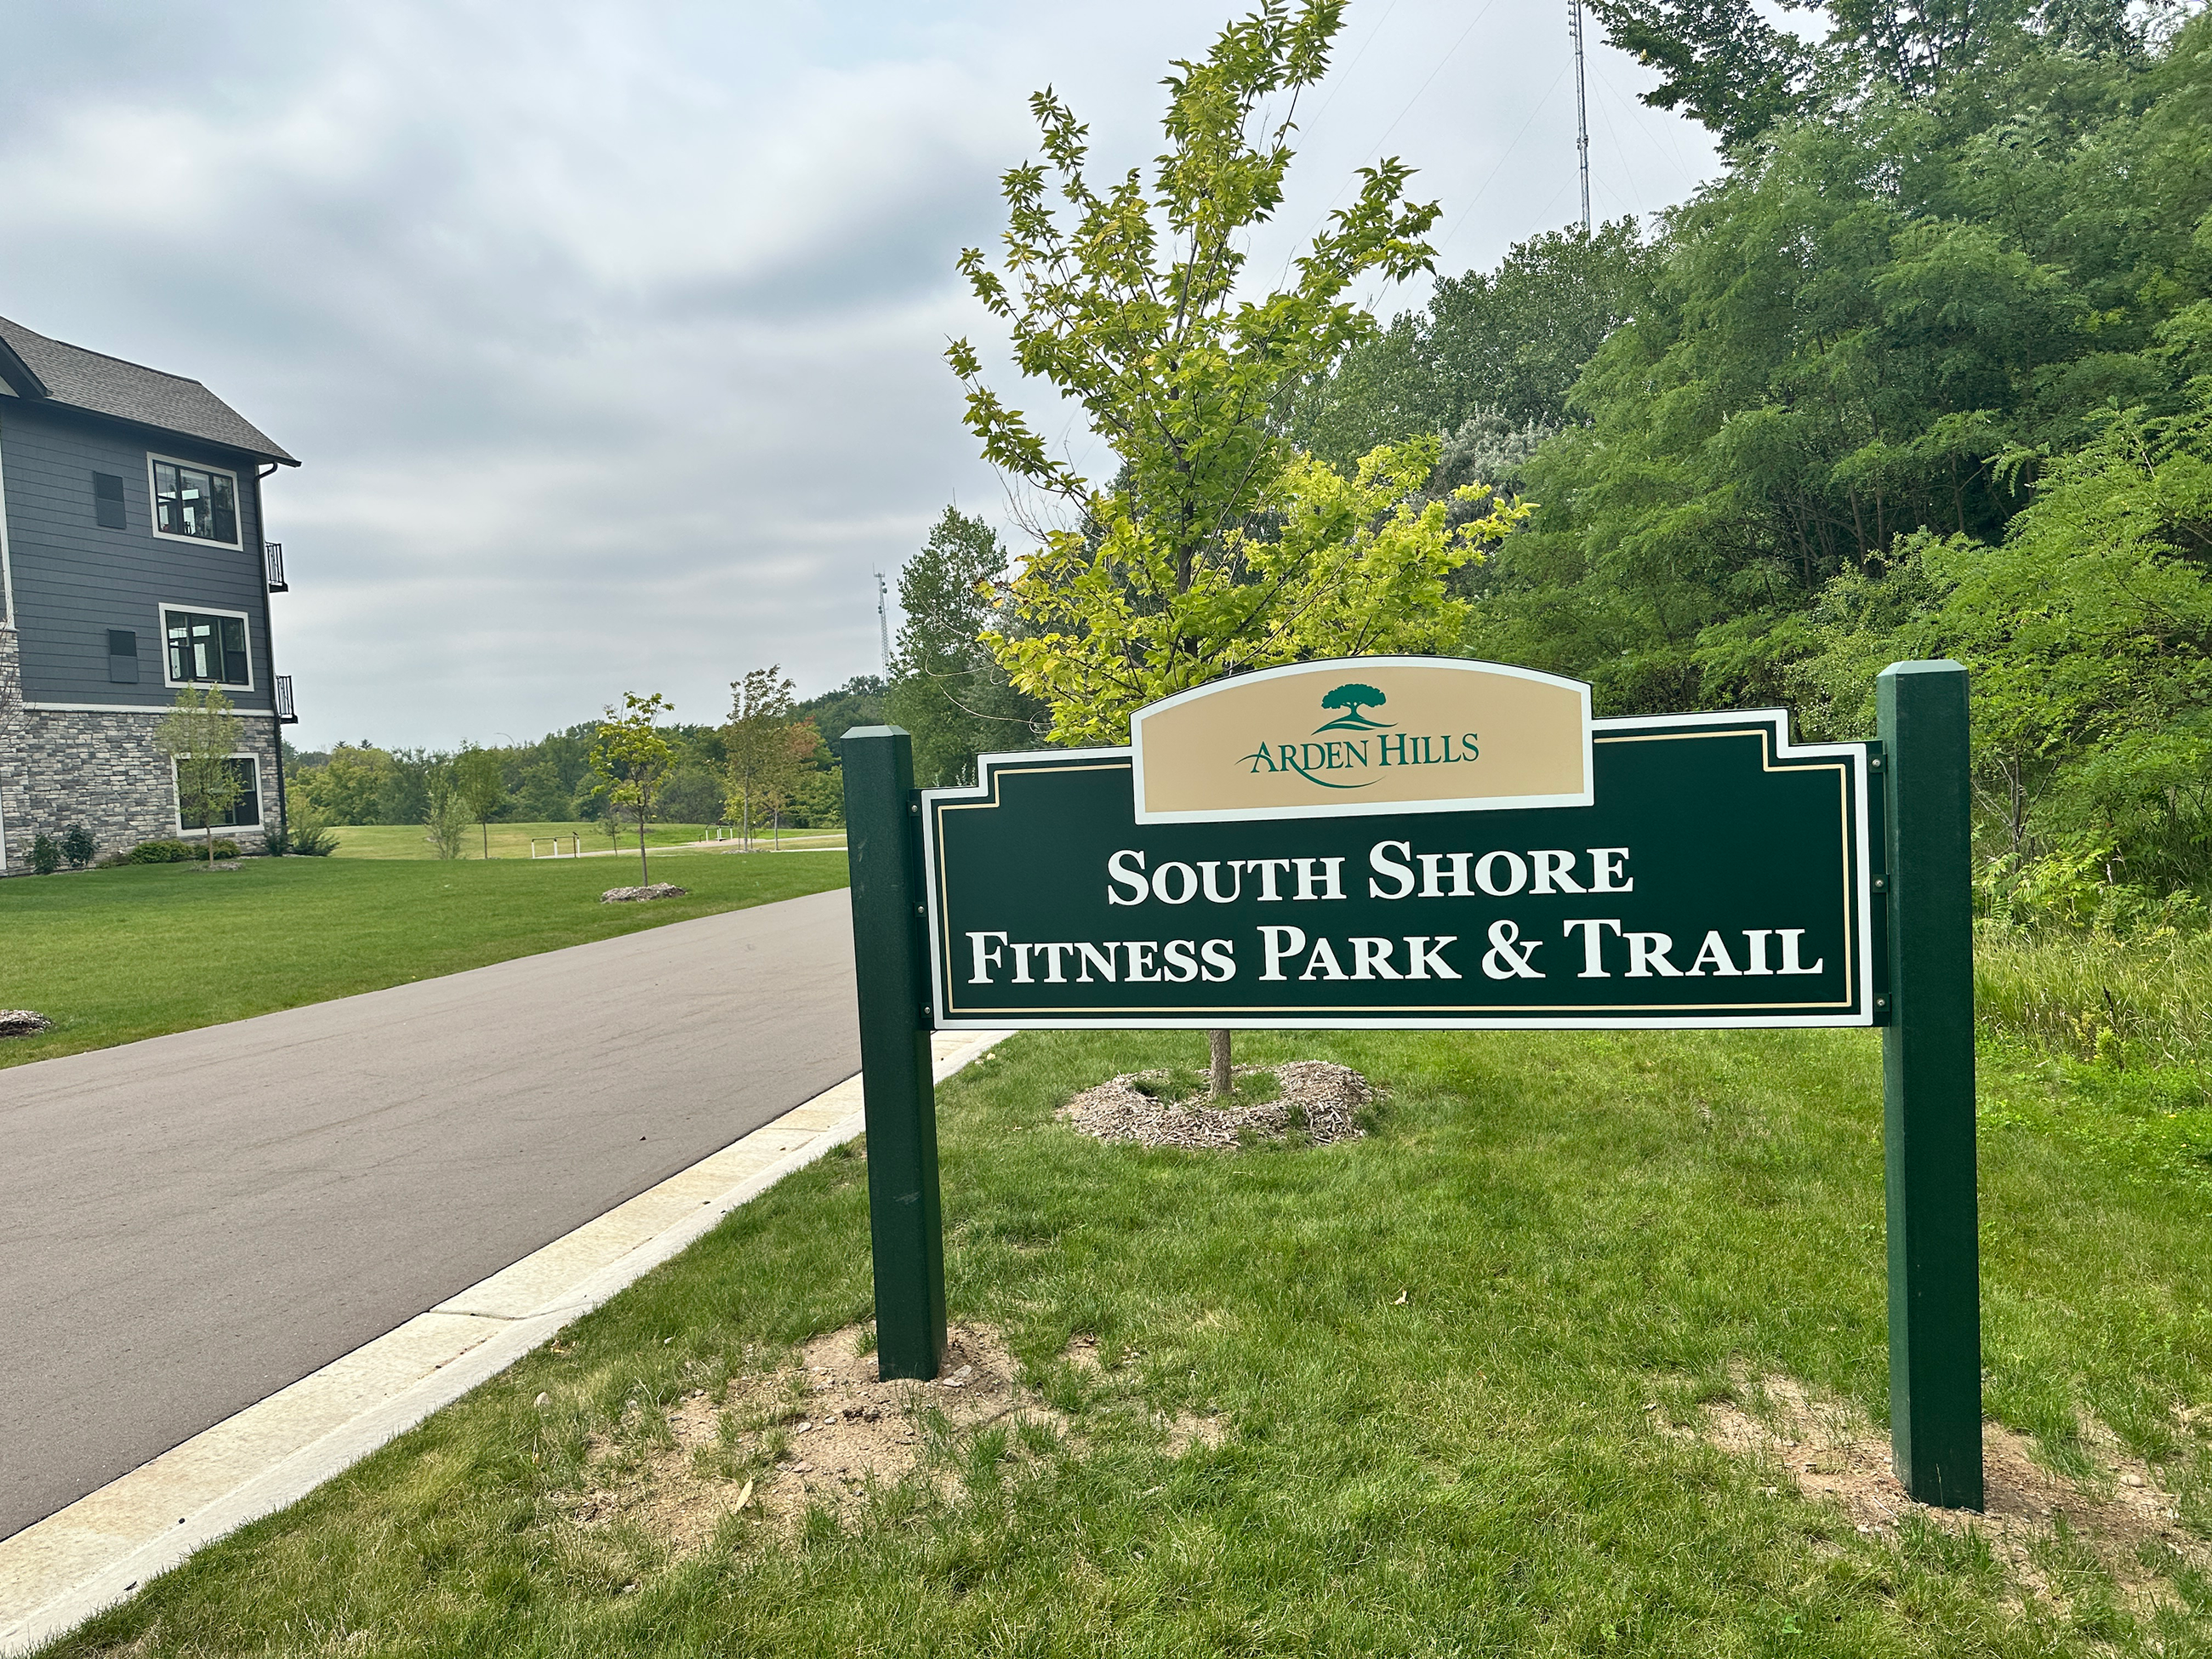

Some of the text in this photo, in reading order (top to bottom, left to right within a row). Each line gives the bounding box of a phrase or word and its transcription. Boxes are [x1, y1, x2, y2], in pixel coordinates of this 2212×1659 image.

[1235, 732, 1479, 779] ARDEN HILLS
[1107, 839, 1633, 906] SOUTH SHORE
[965, 918, 1824, 984] FITNESS PARK & TRAIL
